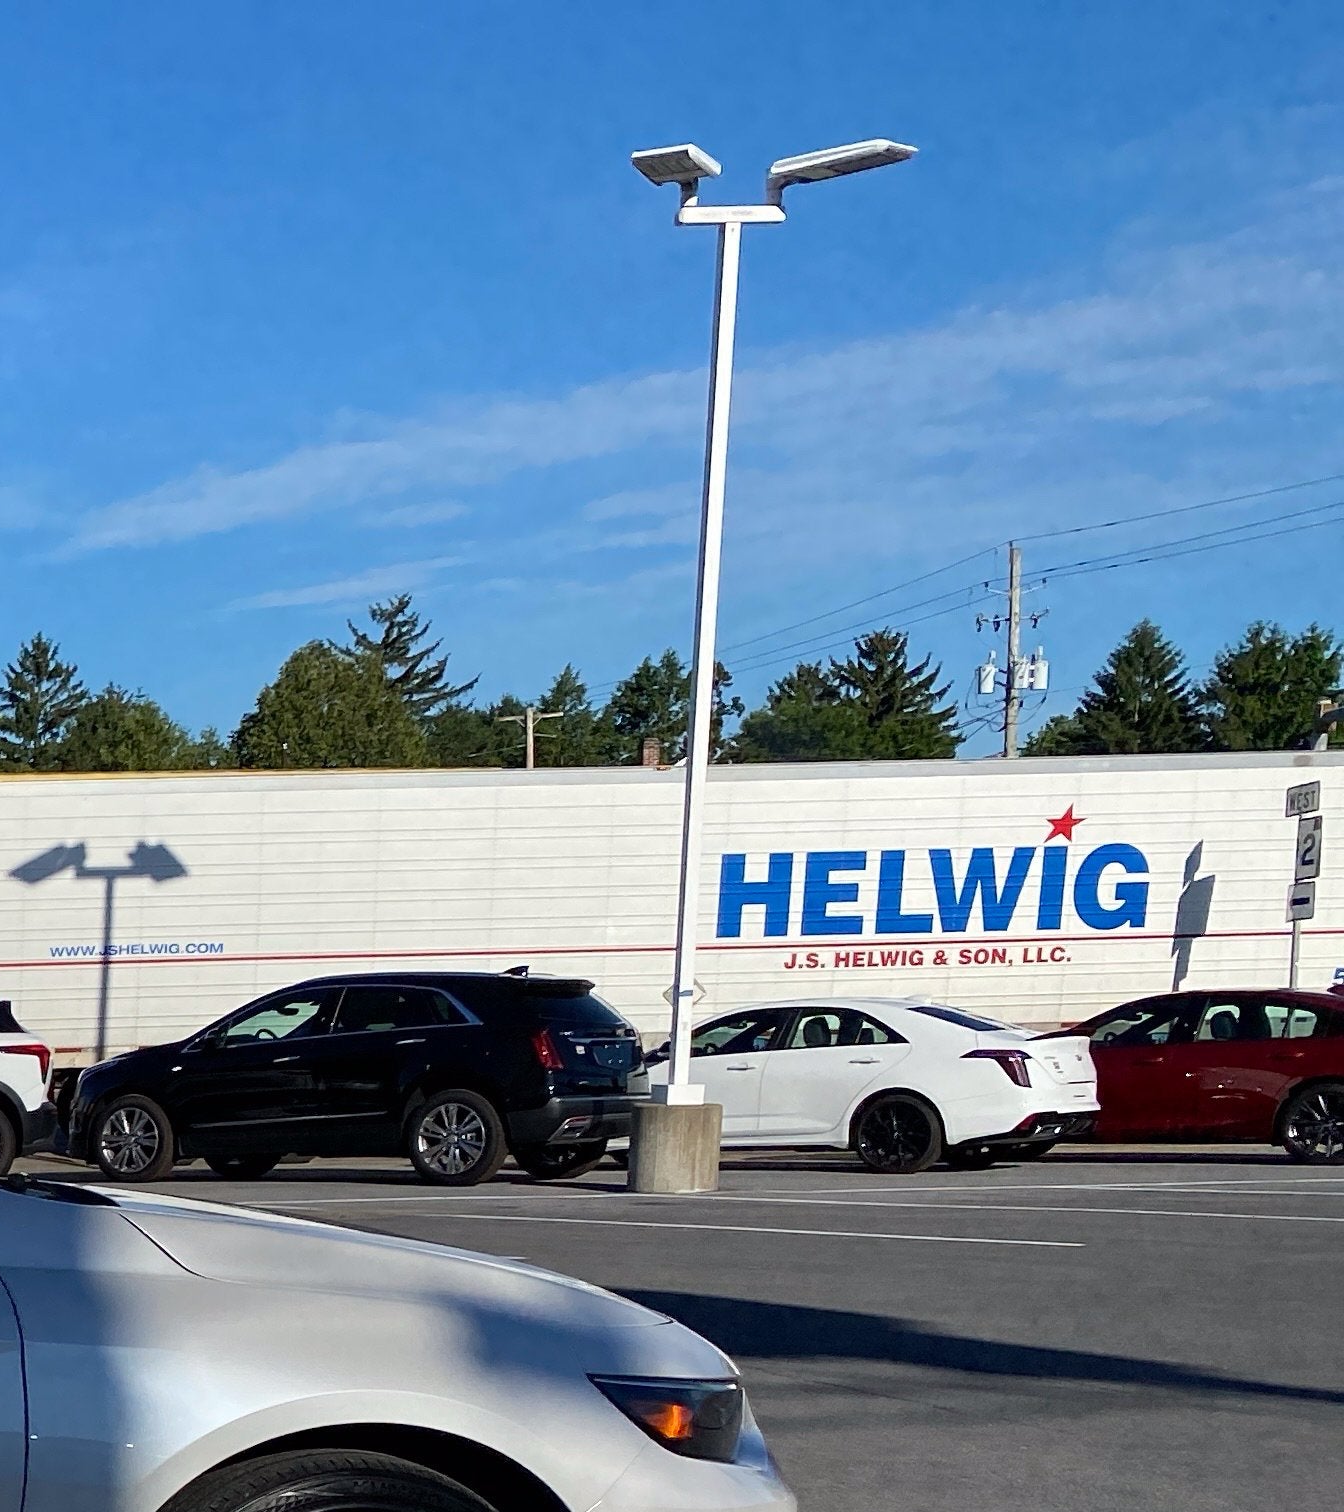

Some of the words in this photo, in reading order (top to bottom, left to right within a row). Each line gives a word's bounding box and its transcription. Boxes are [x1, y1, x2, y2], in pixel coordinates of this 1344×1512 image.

[1289, 790, 1316, 812] WEST
[716, 842, 1150, 938] HELWIG
[49, 942, 225, 958] WWW.JSHELWIG.COM
[784, 951, 825, 970] J.S.
[833, 949, 925, 968] HELWIG
[932, 949, 948, 966] &
[958, 947, 1015, 966] SON,
[1022, 946, 1072, 964] LLC.
